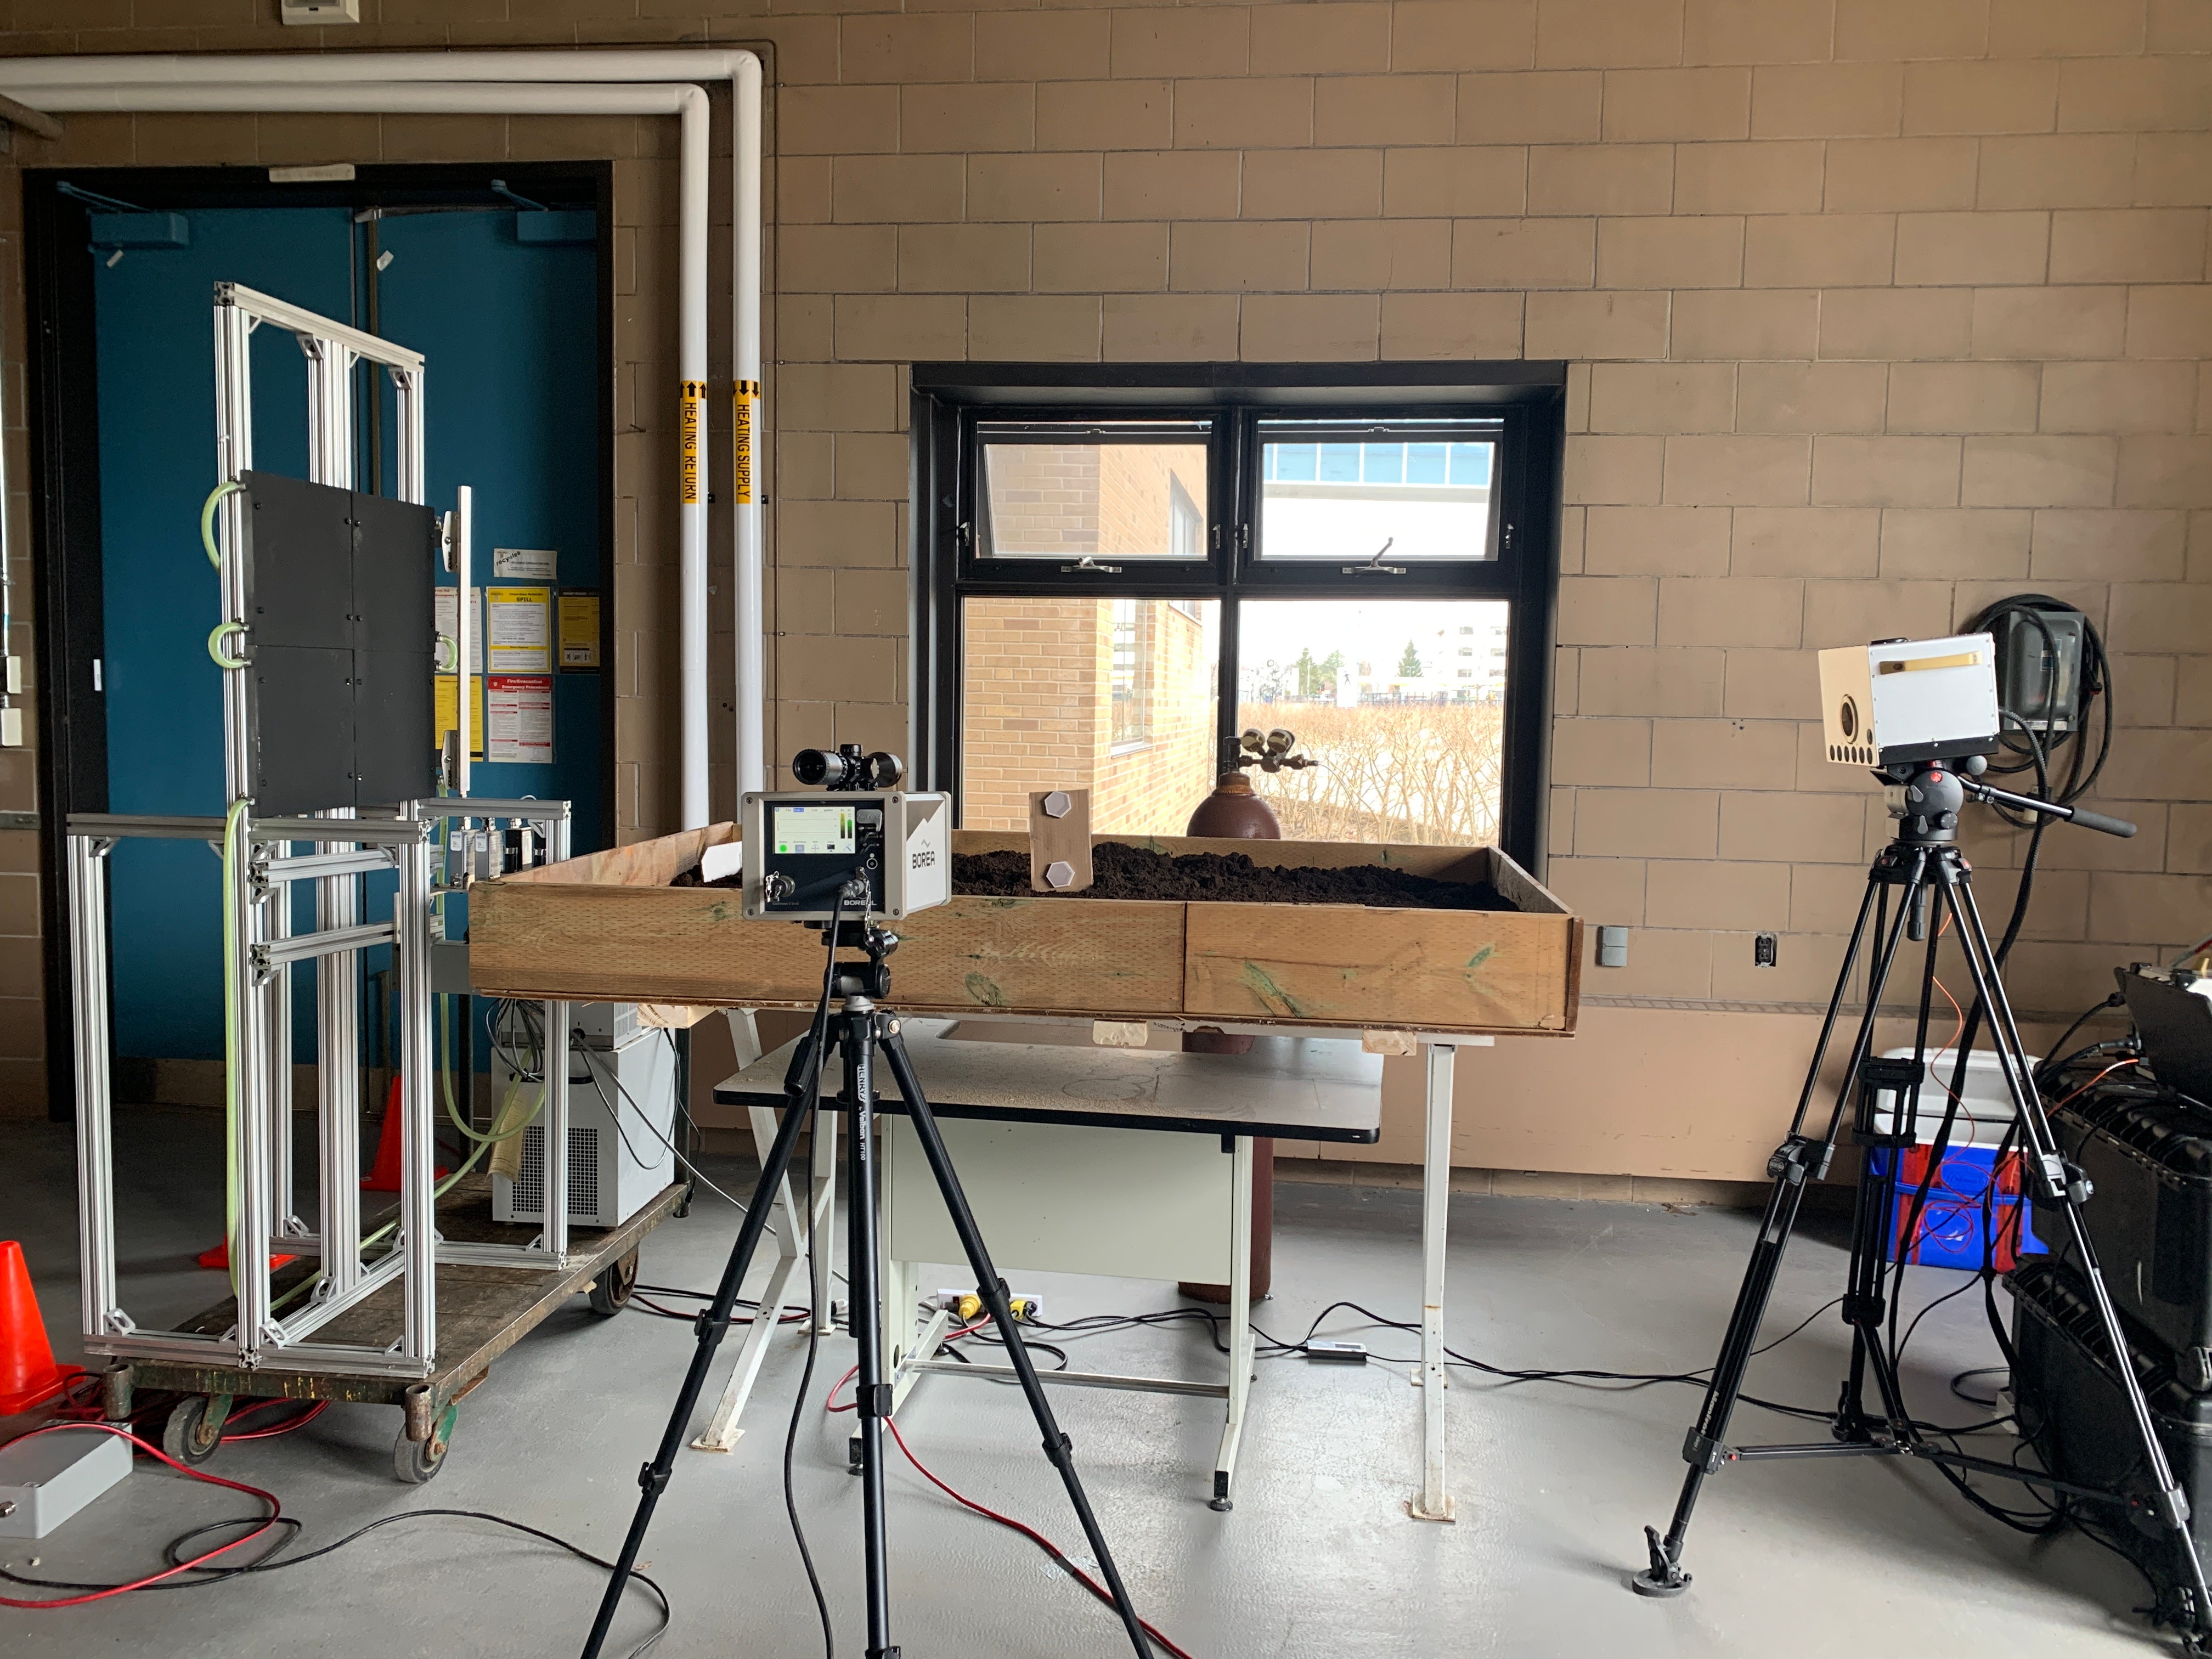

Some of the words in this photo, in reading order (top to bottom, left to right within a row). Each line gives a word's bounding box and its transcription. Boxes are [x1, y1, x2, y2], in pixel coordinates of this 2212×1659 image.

[684, 402, 697, 449] HEATING
[737, 404, 751, 452] HEATING
[684, 456, 697, 499] RETURN
[737, 455, 751, 497] SUPPLY
[912, 850, 935, 869] BOREA
